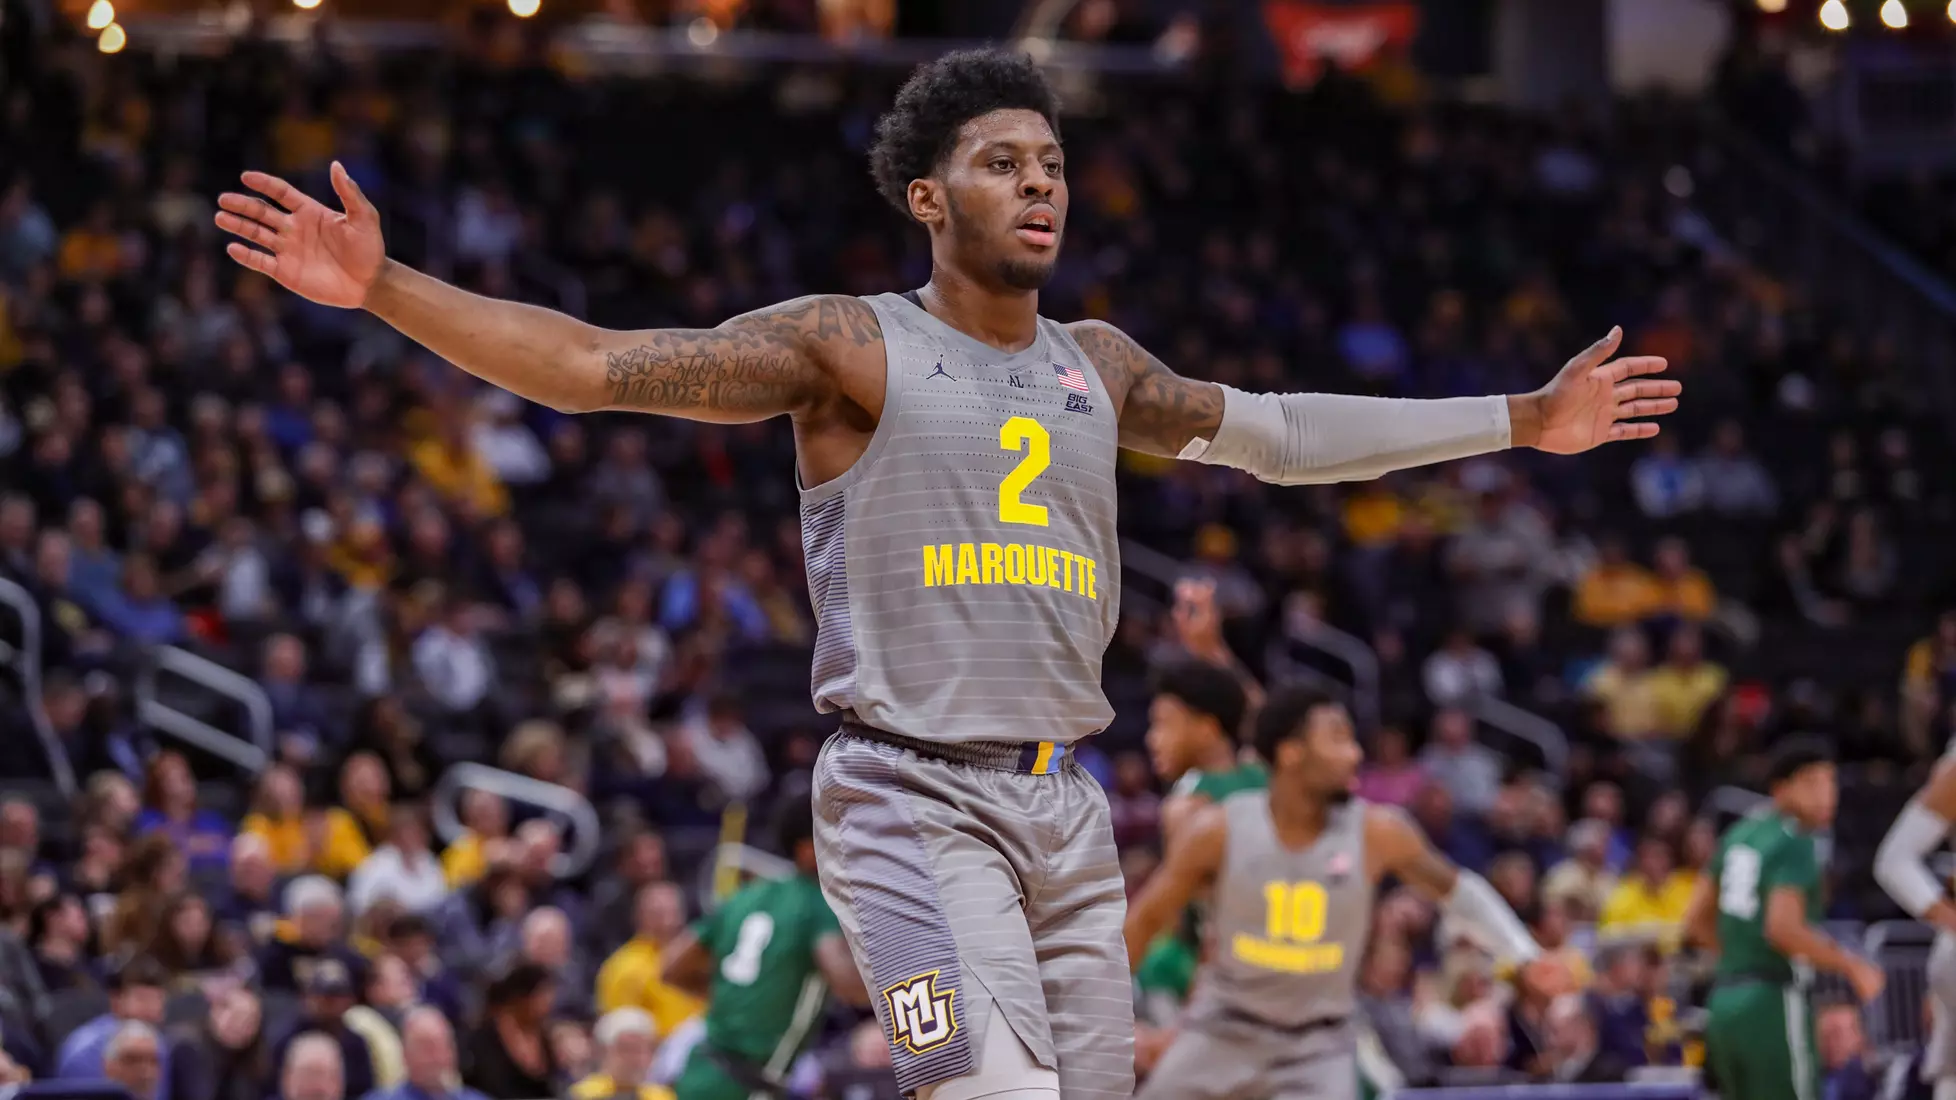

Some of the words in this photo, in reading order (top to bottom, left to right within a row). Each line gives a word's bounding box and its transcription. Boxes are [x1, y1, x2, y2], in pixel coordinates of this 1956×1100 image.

[1065, 400, 1093, 413] EAST
[1067, 393, 1088, 404] BIG
[999, 416, 1050, 527] 2
[922, 542, 1097, 600] MARQUETTE
[1263, 880, 1329, 942] 10
[886, 973, 954, 1051] MU
